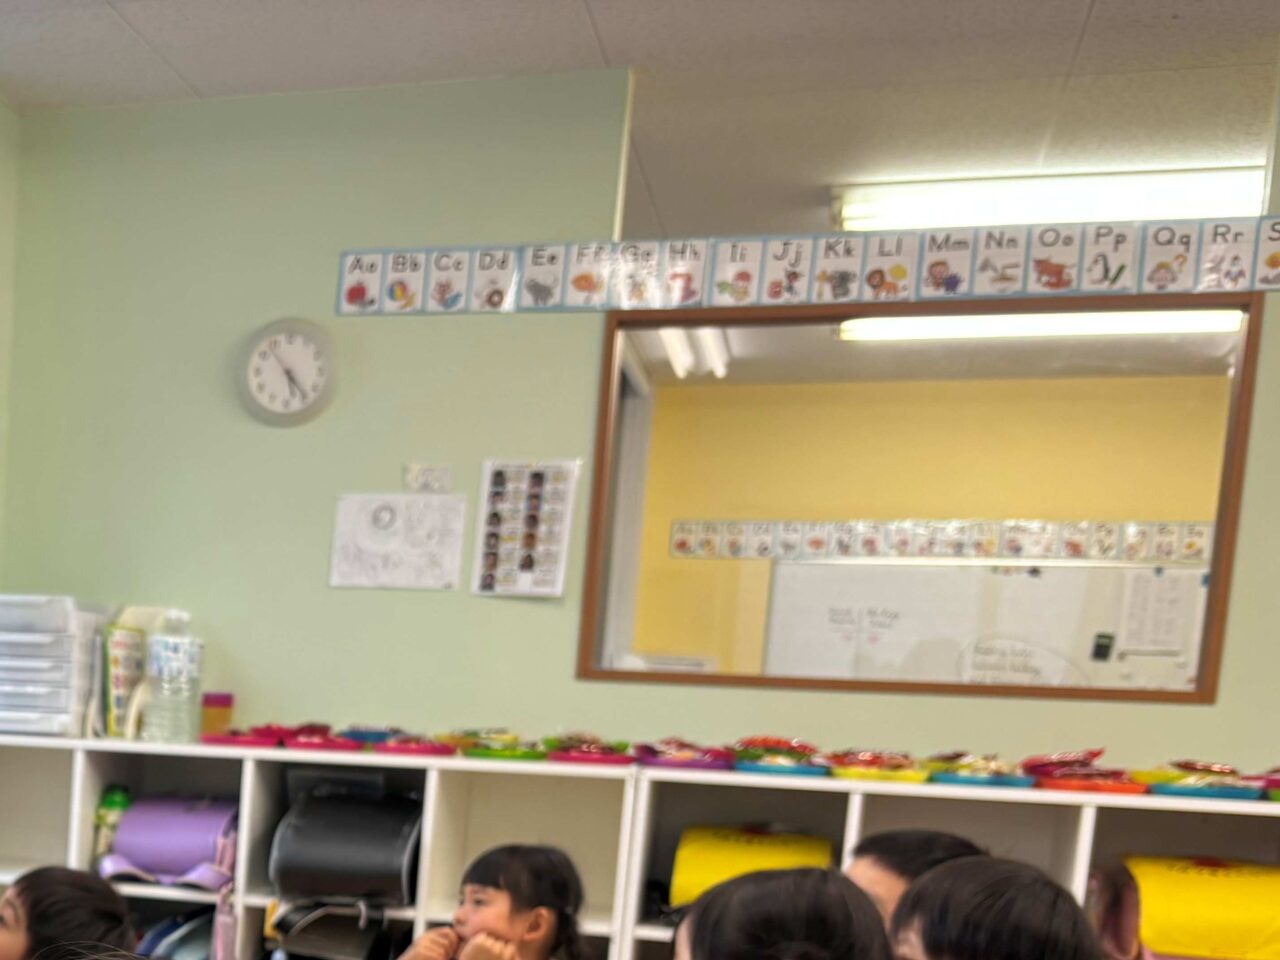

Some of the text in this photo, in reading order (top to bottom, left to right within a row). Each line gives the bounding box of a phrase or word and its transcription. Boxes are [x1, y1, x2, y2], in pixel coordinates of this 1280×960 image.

[391, 255, 421, 272] Bb
[434, 254, 464, 272] Cc
[479, 252, 510, 271] Dd
[532, 246, 558, 267] Ee
[773, 239, 802, 268] Jj
[824, 238, 855, 258] Kk
[928, 233, 969, 252] Mm
[985, 231, 1017, 249] Nn
[1039, 228, 1074, 247] Oo
[1094, 226, 1127, 252] Pp
[1154, 226, 1191, 252] Qq
[1212, 224, 1245, 243] Rr
